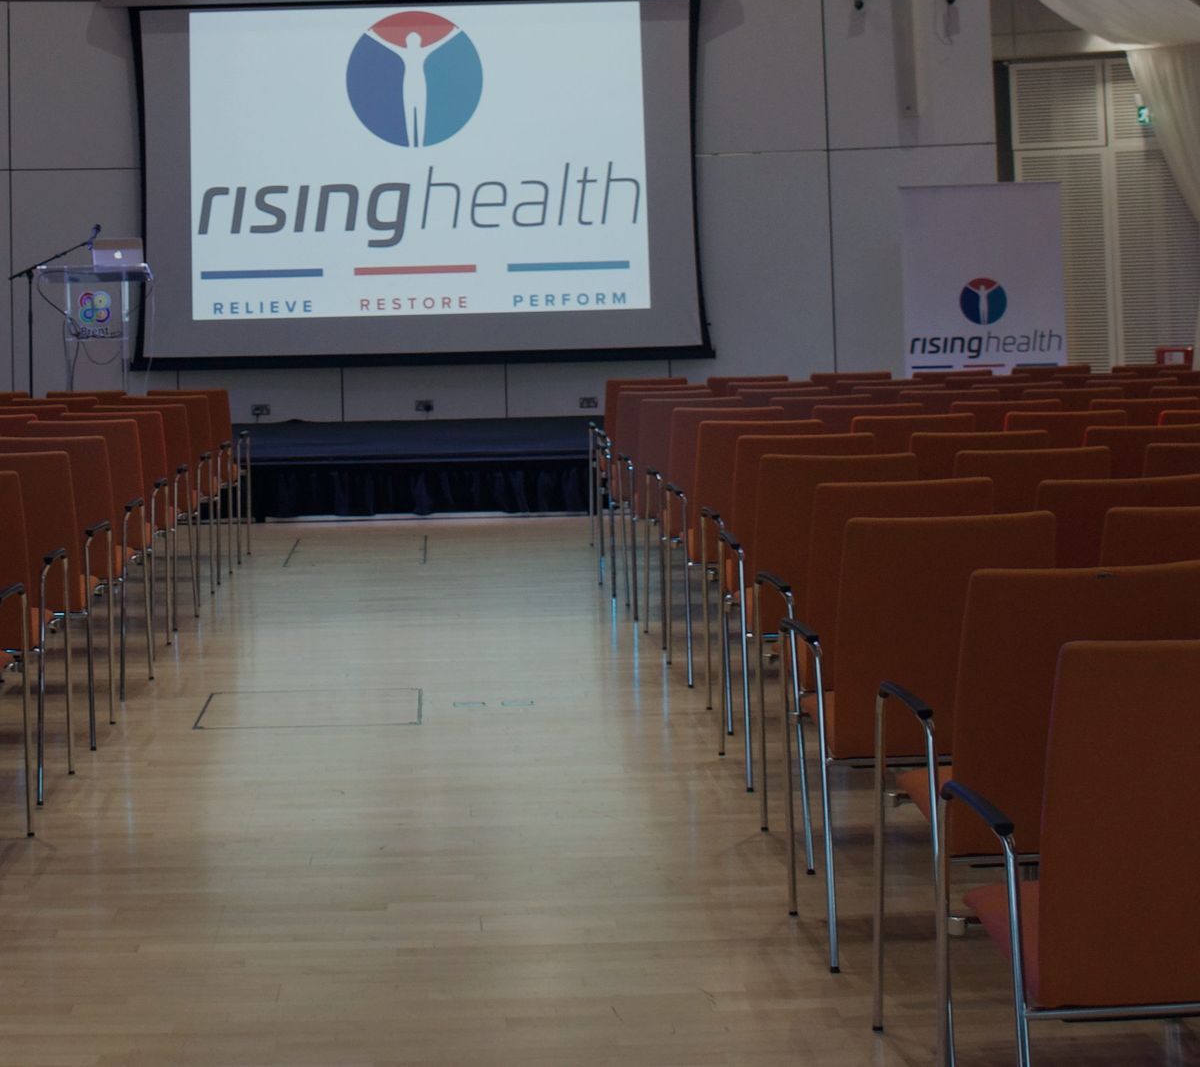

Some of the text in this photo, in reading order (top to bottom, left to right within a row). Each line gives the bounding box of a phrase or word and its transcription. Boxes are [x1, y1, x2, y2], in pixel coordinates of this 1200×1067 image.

[212, 292, 628, 315] RELIEVE RESTORE PERFORM
